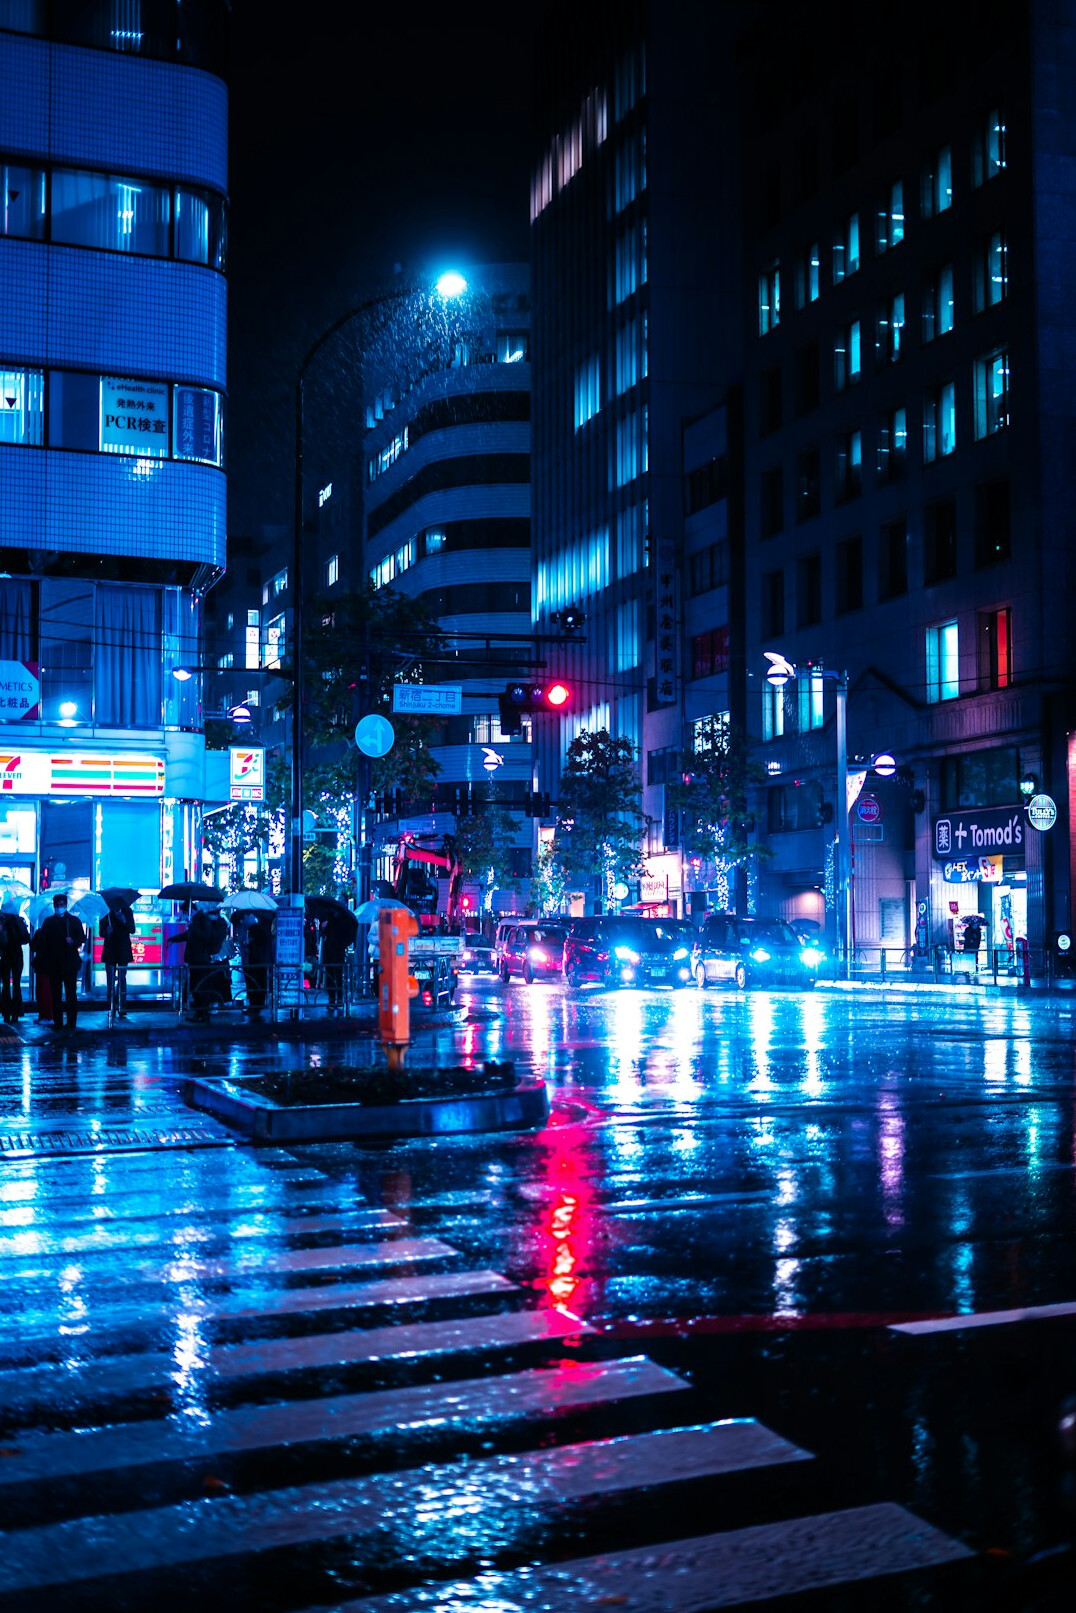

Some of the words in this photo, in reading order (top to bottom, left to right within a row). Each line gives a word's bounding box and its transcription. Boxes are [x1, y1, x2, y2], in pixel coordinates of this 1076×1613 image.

[116, 384, 145, 393] eHealth
[146, 386, 165, 395] clinic
[116, 398, 156, 411] 発熱外来
[105, 414, 167, 434] PCR検査
[399, 689, 456, 701] 新宿二丁目
[399, 701, 426, 709] Shinjuku
[427, 701, 456, 710] 2-chome
[938, 825, 949, 848] 薬
[969, 814, 1022, 847] Tomod's
